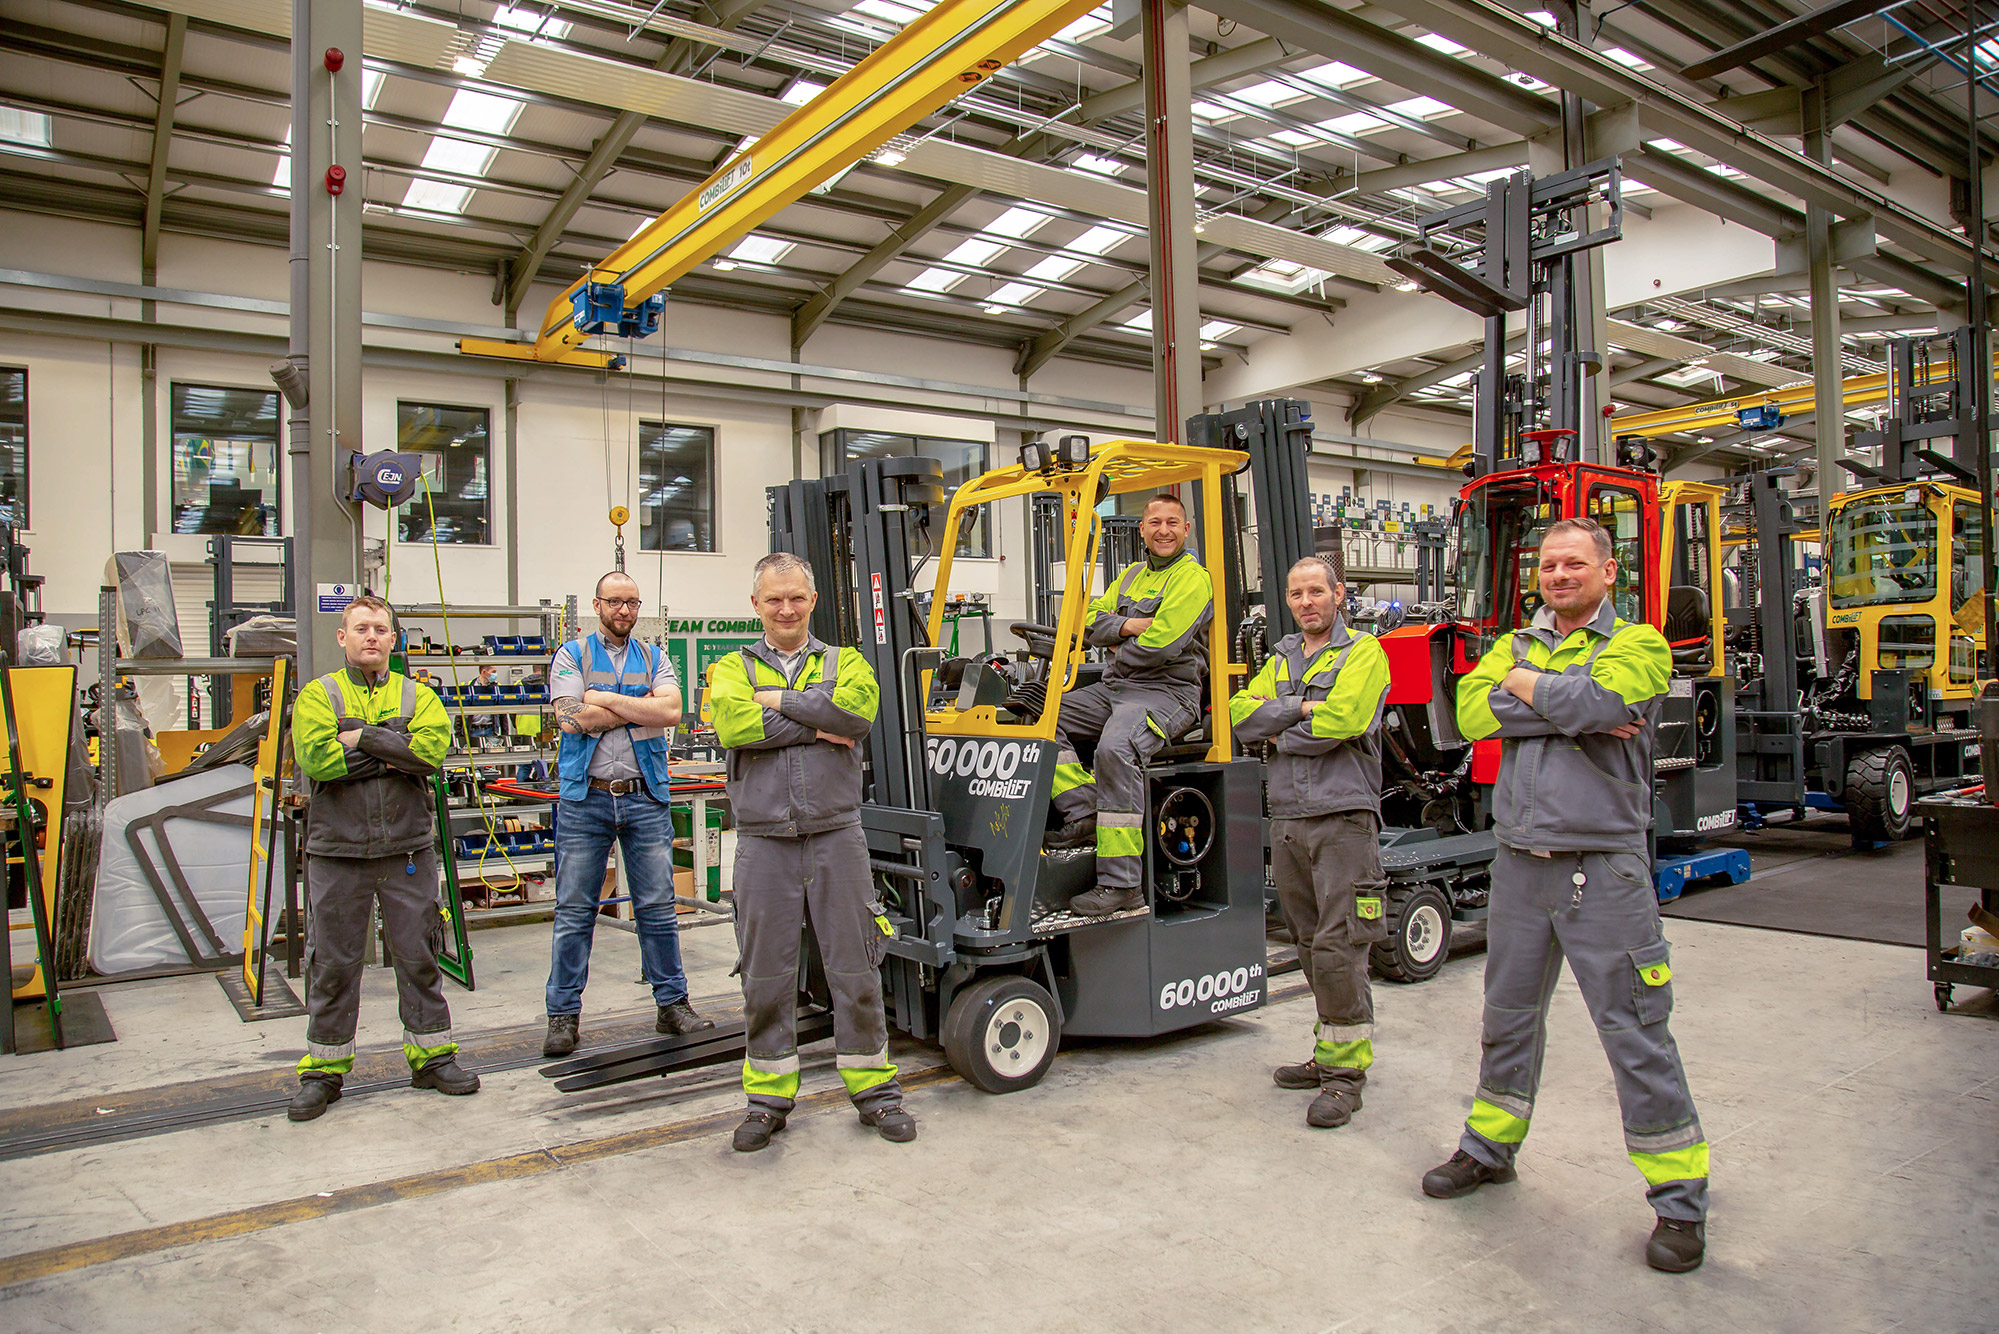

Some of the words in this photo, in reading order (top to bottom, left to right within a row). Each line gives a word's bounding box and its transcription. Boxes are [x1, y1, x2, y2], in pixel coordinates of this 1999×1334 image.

[739, 160, 751, 178] 10t
[377, 468, 402, 485] CEJN
[667, 620, 704, 633] EAM
[1160, 963, 1263, 1010] 60,000th
